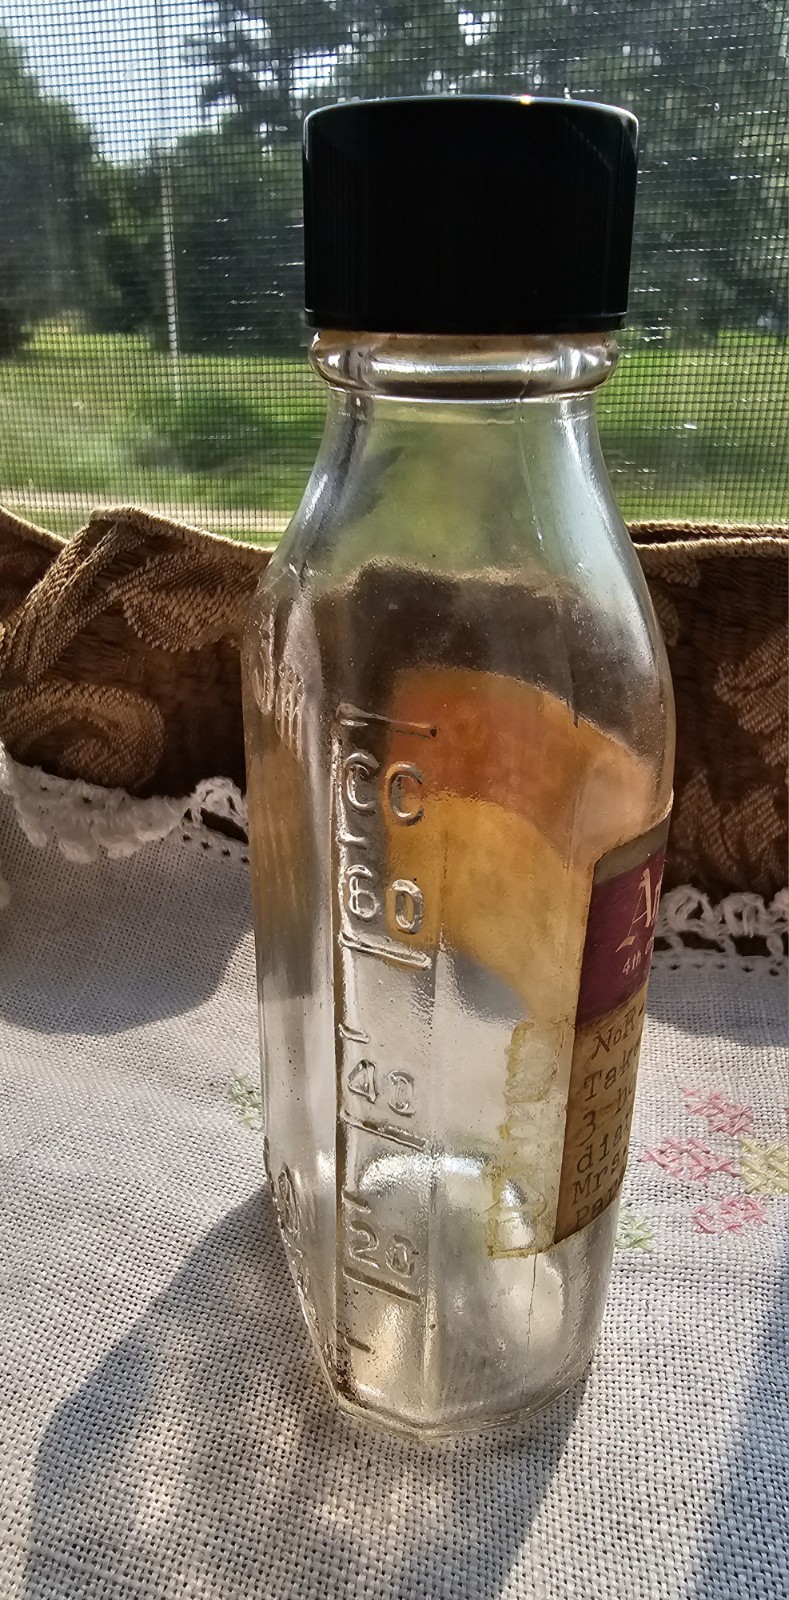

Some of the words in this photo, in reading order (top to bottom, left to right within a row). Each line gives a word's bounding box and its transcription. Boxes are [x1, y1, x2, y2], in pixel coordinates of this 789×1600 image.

[346, 864, 425, 935] 60
[347, 1058, 416, 1118] 40
[348, 1219, 417, 1278] 20
